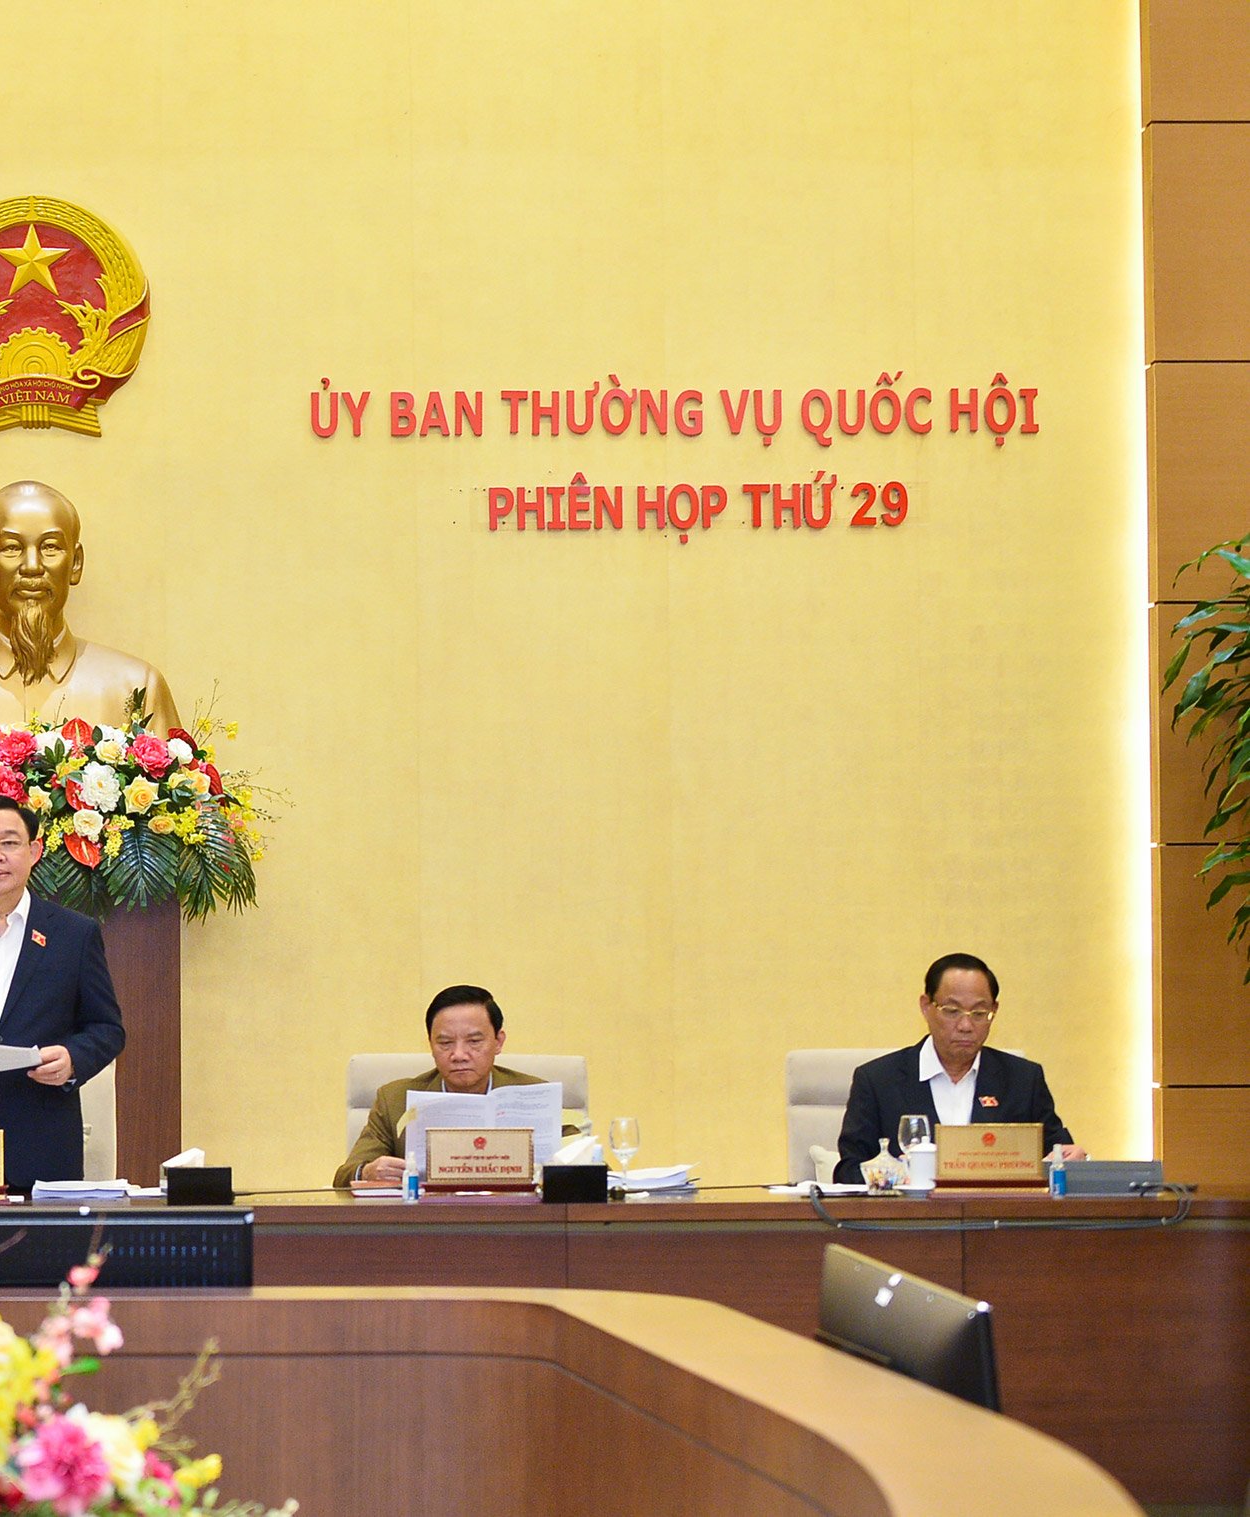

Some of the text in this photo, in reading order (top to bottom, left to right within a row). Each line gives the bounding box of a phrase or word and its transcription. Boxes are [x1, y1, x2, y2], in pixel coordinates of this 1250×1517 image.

[0, 389, 70, 404] VIỆT NAM
[310, 371, 1040, 447] ỦY BAN THƯỜNG VỤ QUỐC HỘI
[486, 469, 910, 544] PHIÊN HỌP THỨ 29
